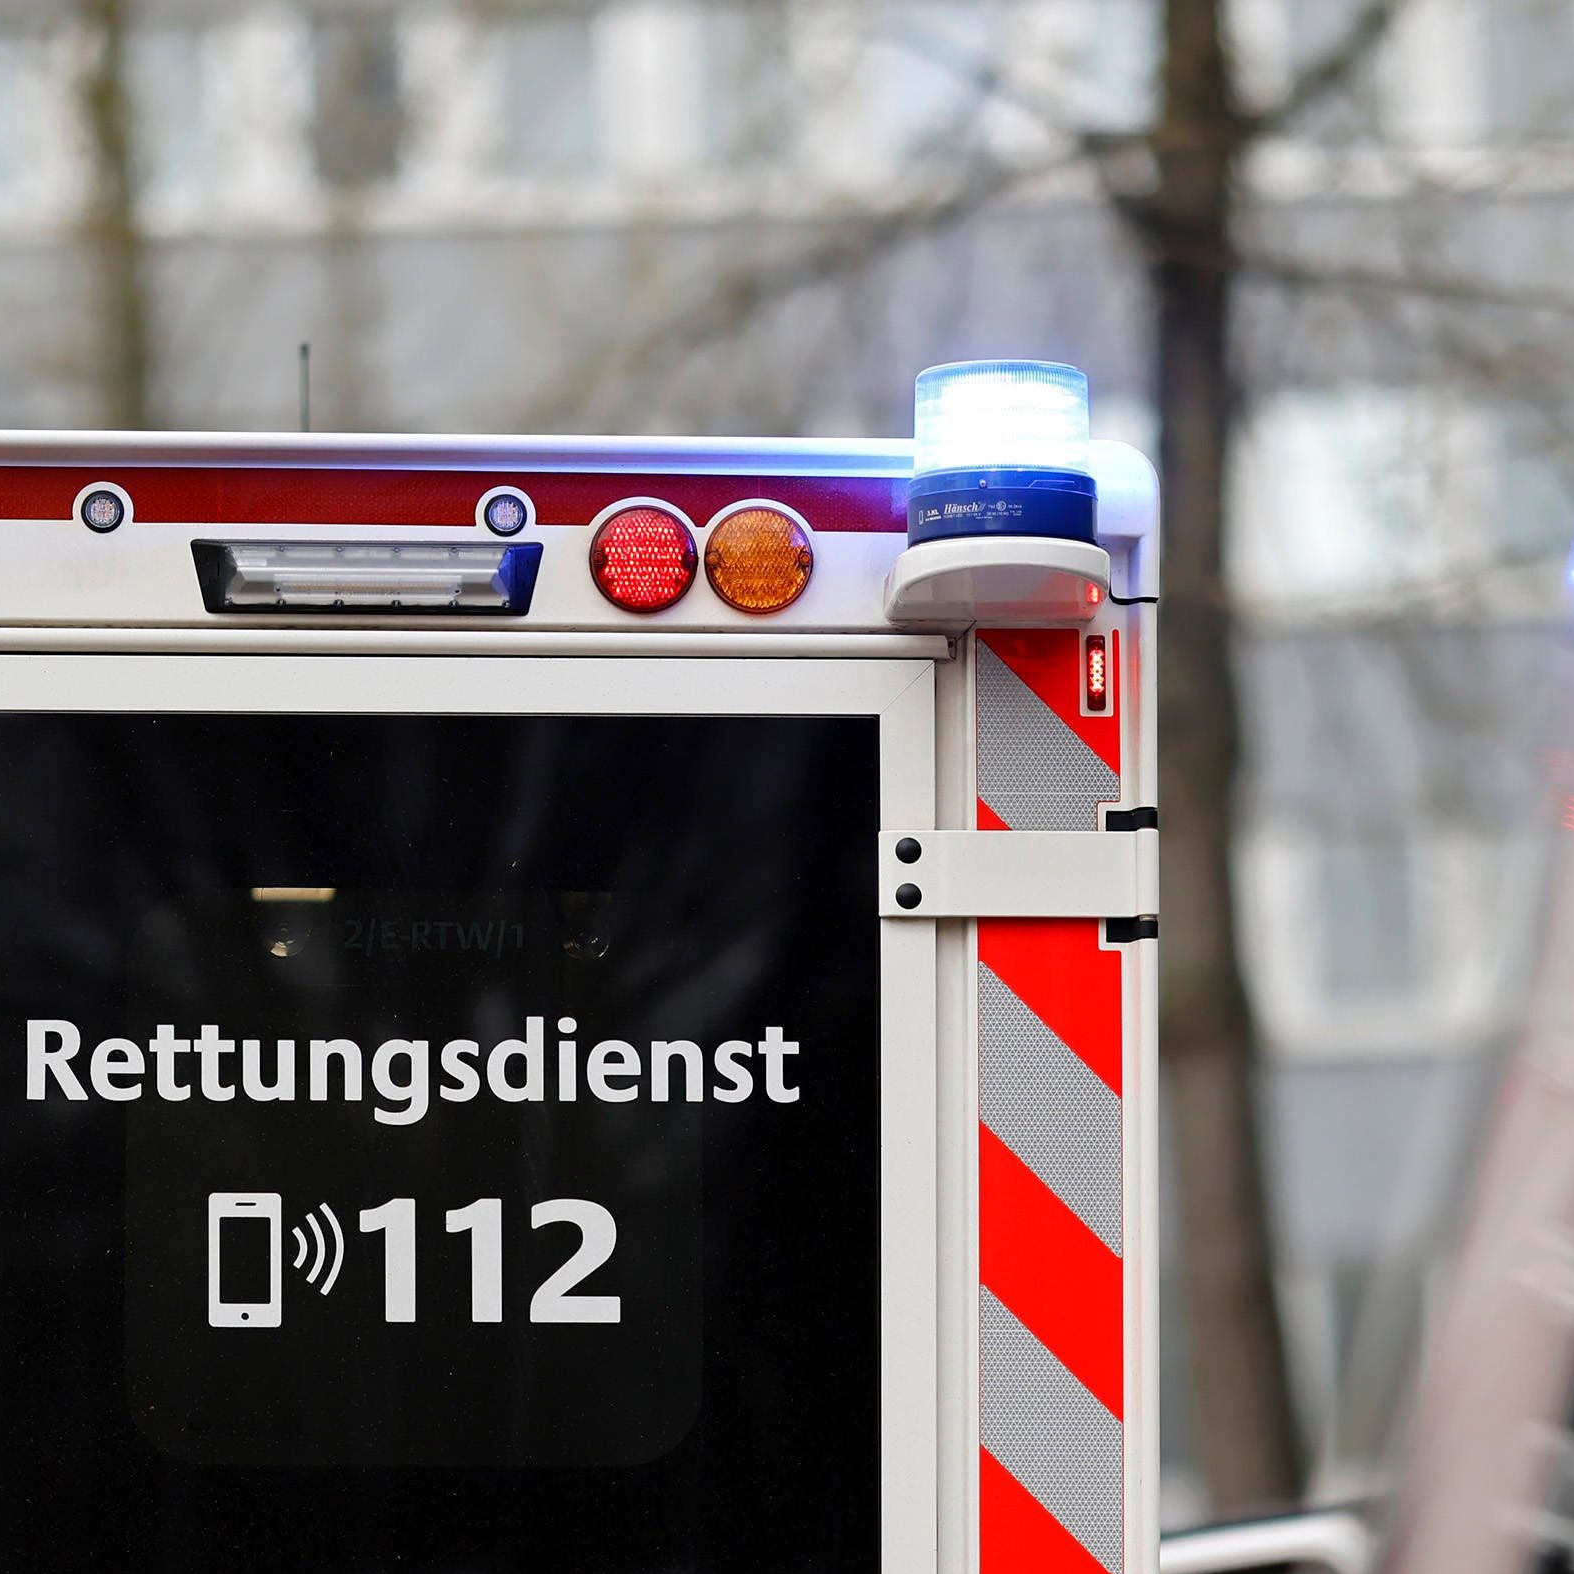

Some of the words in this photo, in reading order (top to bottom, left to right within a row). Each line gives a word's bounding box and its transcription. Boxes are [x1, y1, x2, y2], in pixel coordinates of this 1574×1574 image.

[943, 502, 979, 515] Hänsch
[27, 1017, 799, 1125] Rettungsdienst
[360, 1199, 620, 1323] 112
